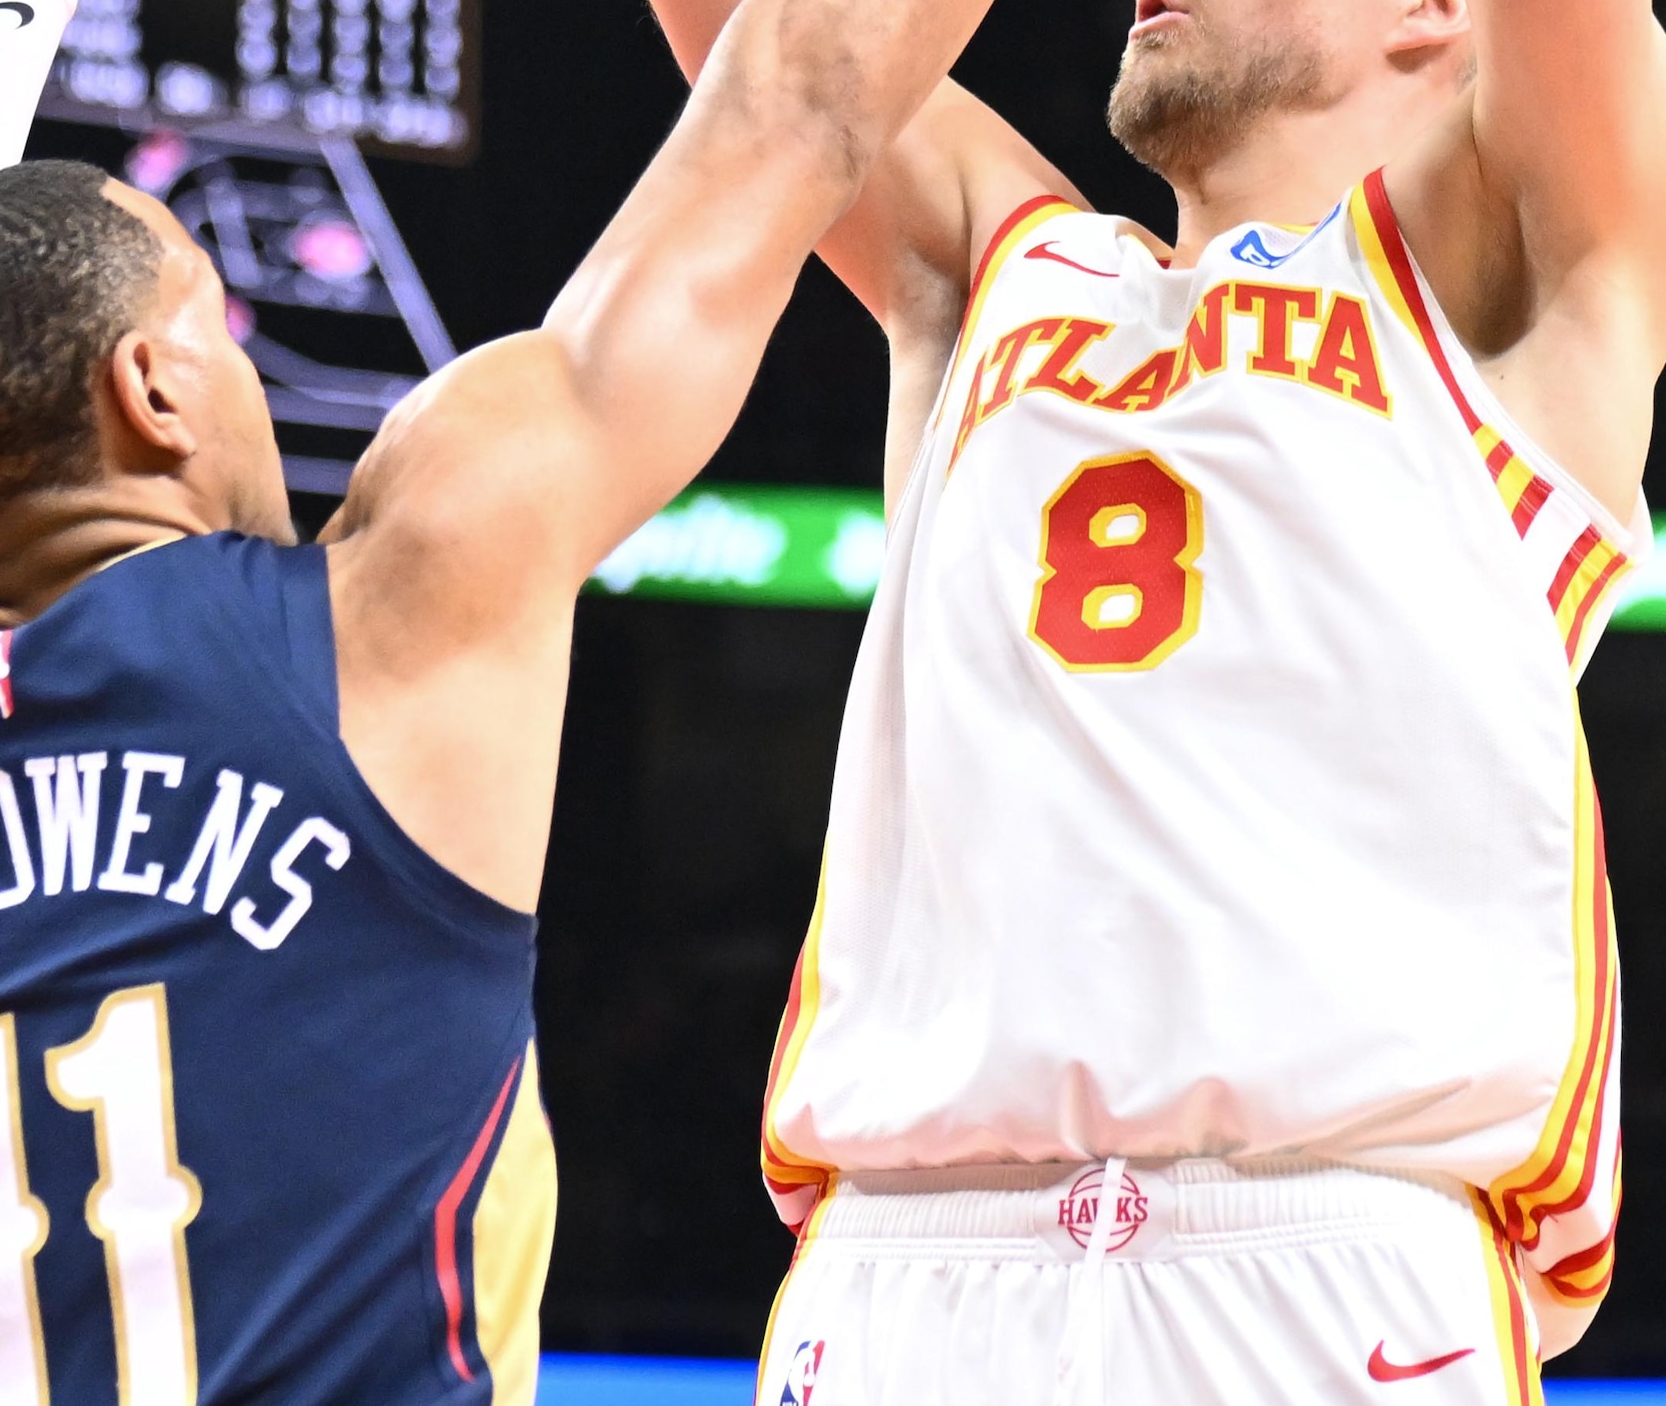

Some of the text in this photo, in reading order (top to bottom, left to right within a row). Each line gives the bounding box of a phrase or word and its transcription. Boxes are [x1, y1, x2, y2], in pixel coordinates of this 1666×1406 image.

[945, 280, 1393, 480] ATLANTA
[1027, 450, 1204, 673] 8
[1058, 1196, 1149, 1226] HAKS
